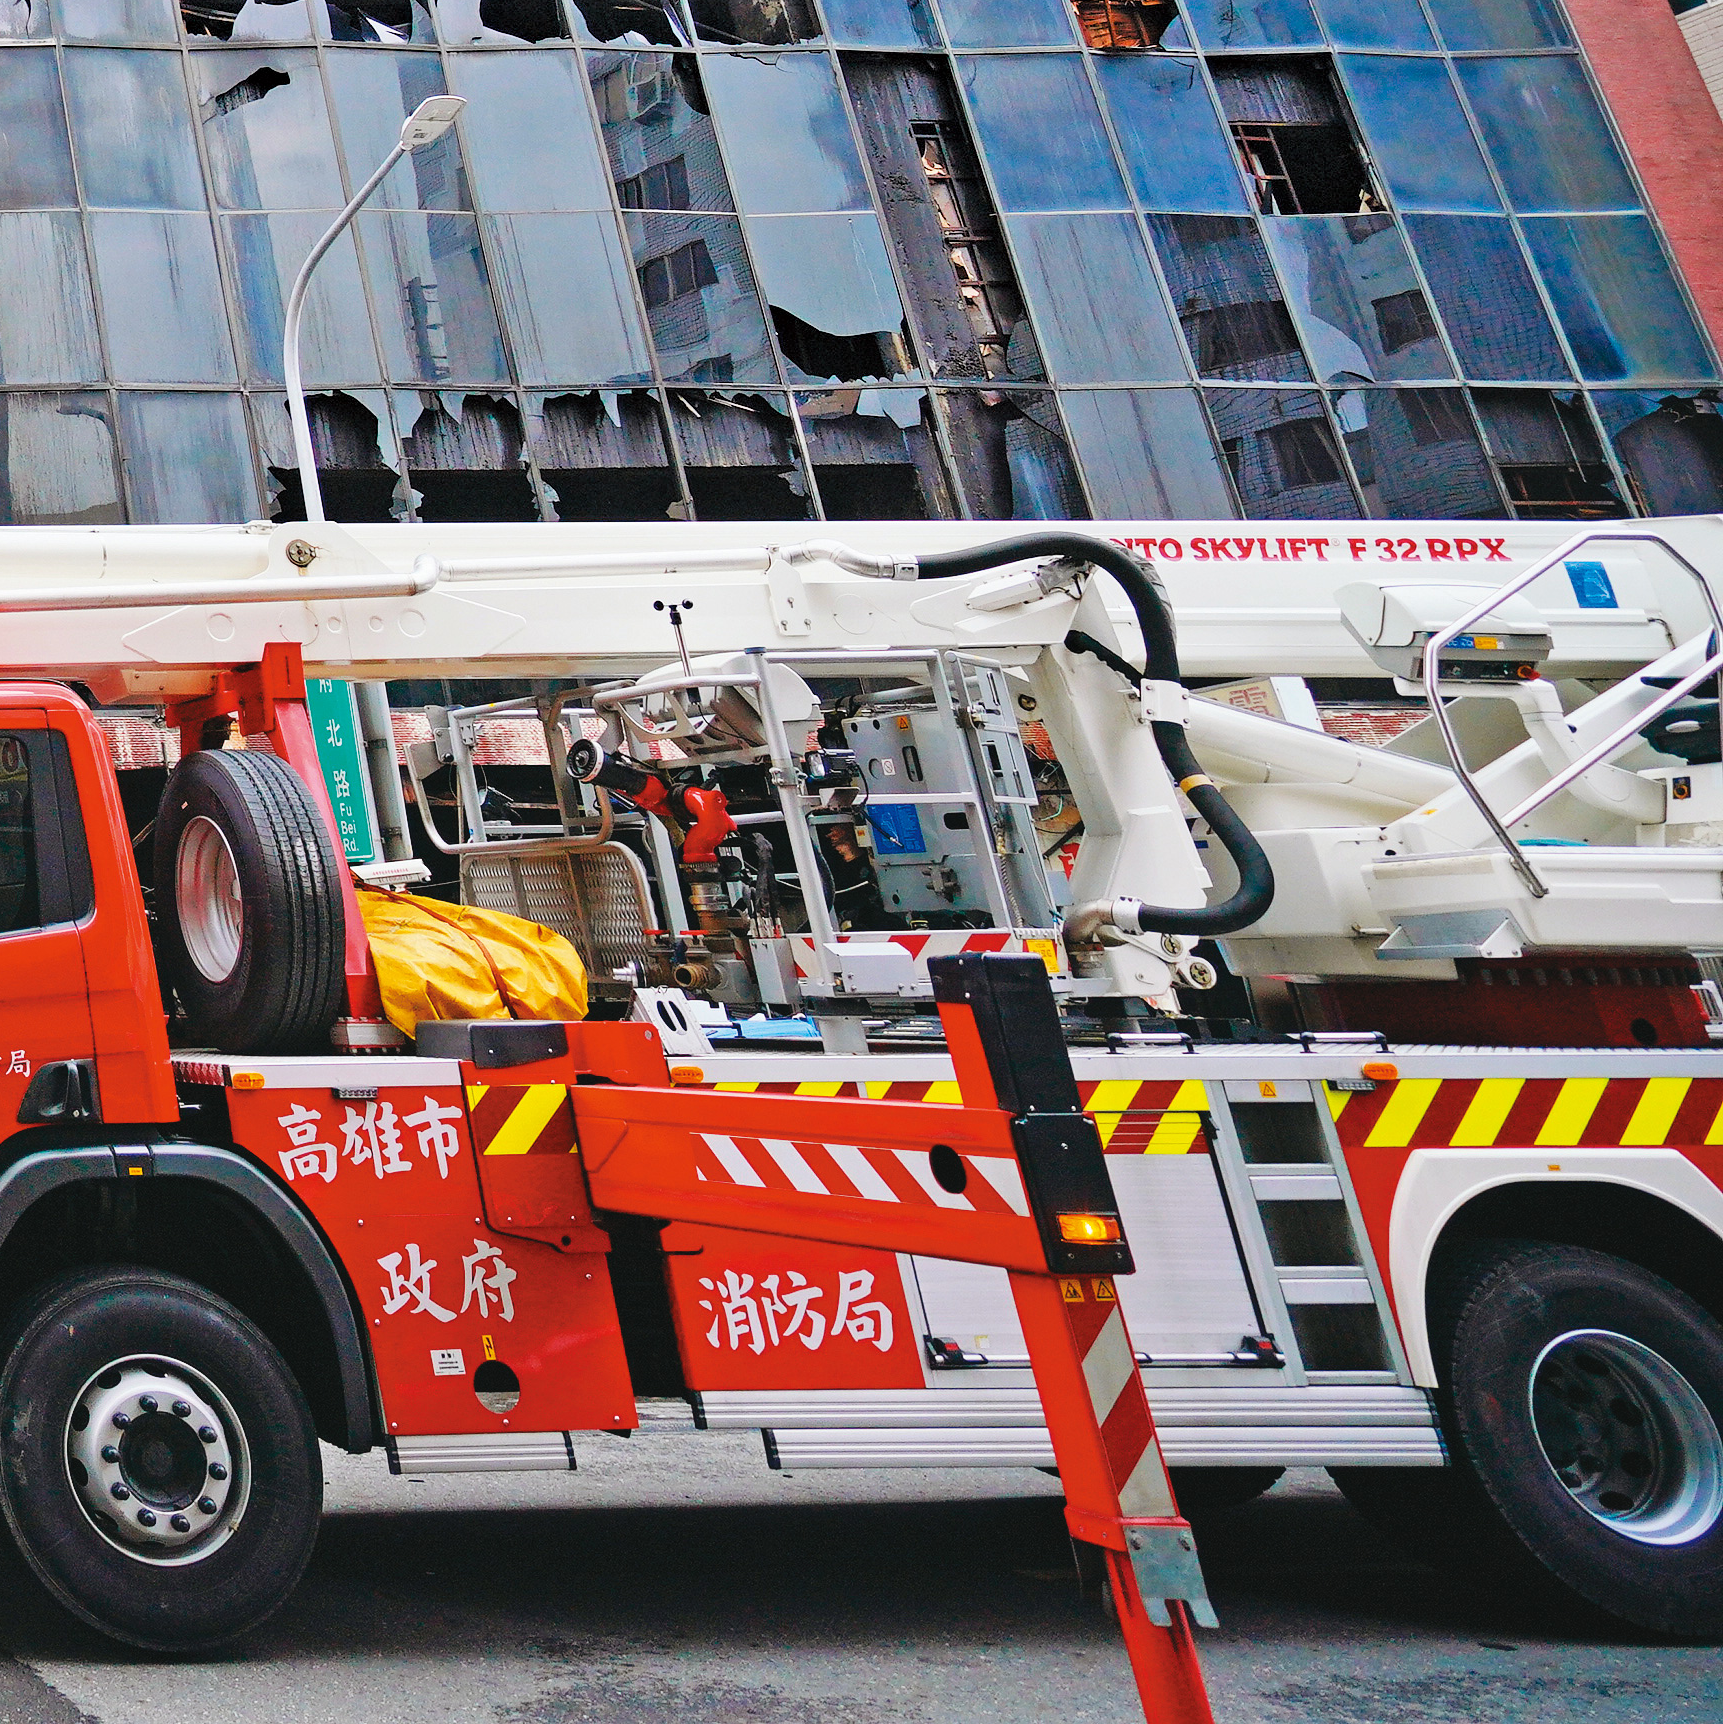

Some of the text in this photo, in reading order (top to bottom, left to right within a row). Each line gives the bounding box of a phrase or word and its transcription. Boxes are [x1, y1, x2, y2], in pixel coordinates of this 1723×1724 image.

[1190, 537, 1331, 563] SKYLIFT
[1347, 538, 1367, 562] F
[1376, 538, 1423, 563] 32
[1425, 538, 1513, 563] RPX
[339, 802, 353, 817] Fu
[341, 821, 357, 835] Bei
[344, 838, 360, 852] Rd.
[277, 1094, 463, 1184] 高雄市
[376, 1238, 517, 1324] 政府
[698, 1268, 895, 1356] 消防局
